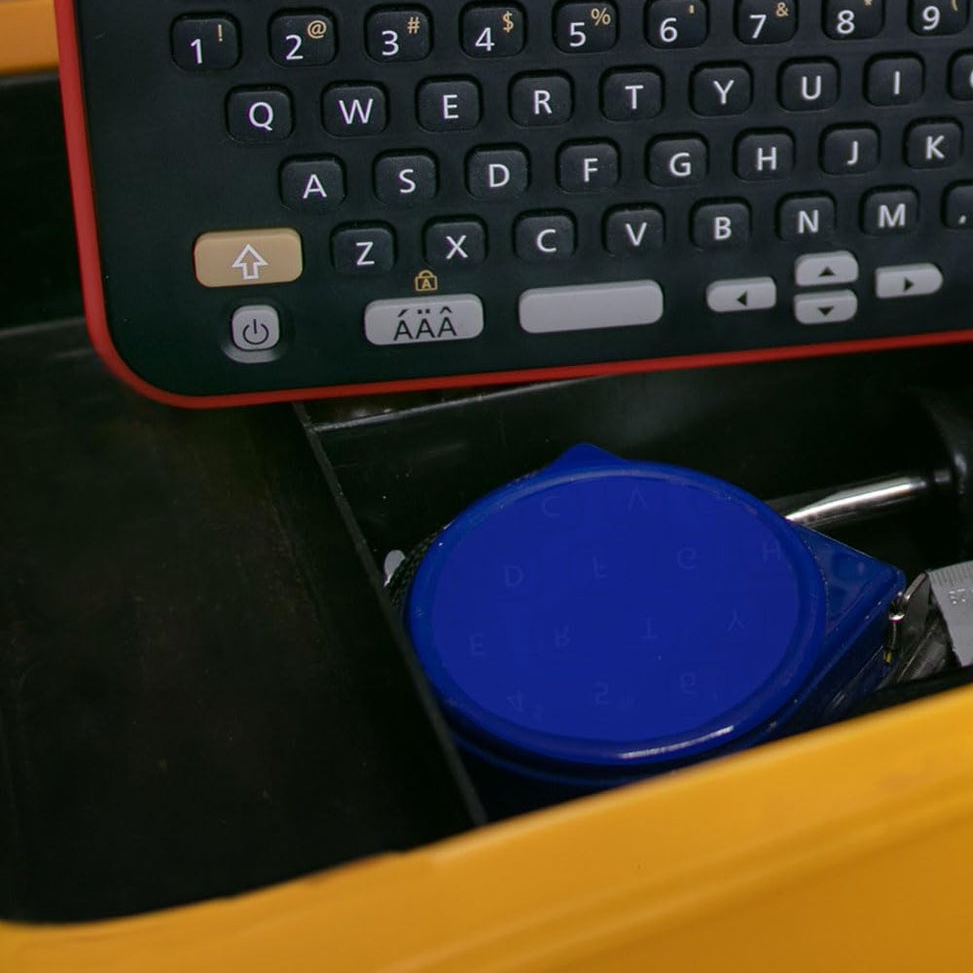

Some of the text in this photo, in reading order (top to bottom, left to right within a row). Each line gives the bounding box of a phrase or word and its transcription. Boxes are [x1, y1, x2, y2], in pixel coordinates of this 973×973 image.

[190, 38, 203, 64] 1
[217, 23, 223, 42] !
[285, 34, 304, 60] 2
[306, 19, 327, 40] @
[381, 30, 399, 56] 3
[407, 16, 421, 34] #
[474, 26, 495, 52] 4
[502, 10, 514, 33] $
[569, 21, 587, 47] 5
[590, 7, 611, 26] %
[659, 17, 678, 43] 6
[749, 14, 767, 39] 7
[775, 1, 789, 17] &
[836, 9, 855, 35] 8
[922, 5, 941, 31] 9
[249, 101, 274, 131] Q
[338, 98, 374, 125] W
[443, 94, 459, 120] E
[534, 89, 553, 115] R
[624, 84, 644, 110] T
[713, 79, 735, 105] Y
[801, 75, 822, 100] U
[894, 70, 901, 95] I
[303, 173, 328, 199] A
[399, 168, 416, 194] S
[488, 163, 510, 188] D
[583, 157, 599, 182] F
[669, 152, 692, 177] G
[757, 146, 777, 171] H
[847, 140, 859, 165] J
[926, 135, 945, 159] K
[355, 241, 375, 266] Z
[445, 234, 468, 260] X
[536, 228, 557, 253] C
[625, 221, 648, 246] V
[714, 216, 732, 240] B
[798, 209, 819, 234] N
[878, 203, 906, 228] M
